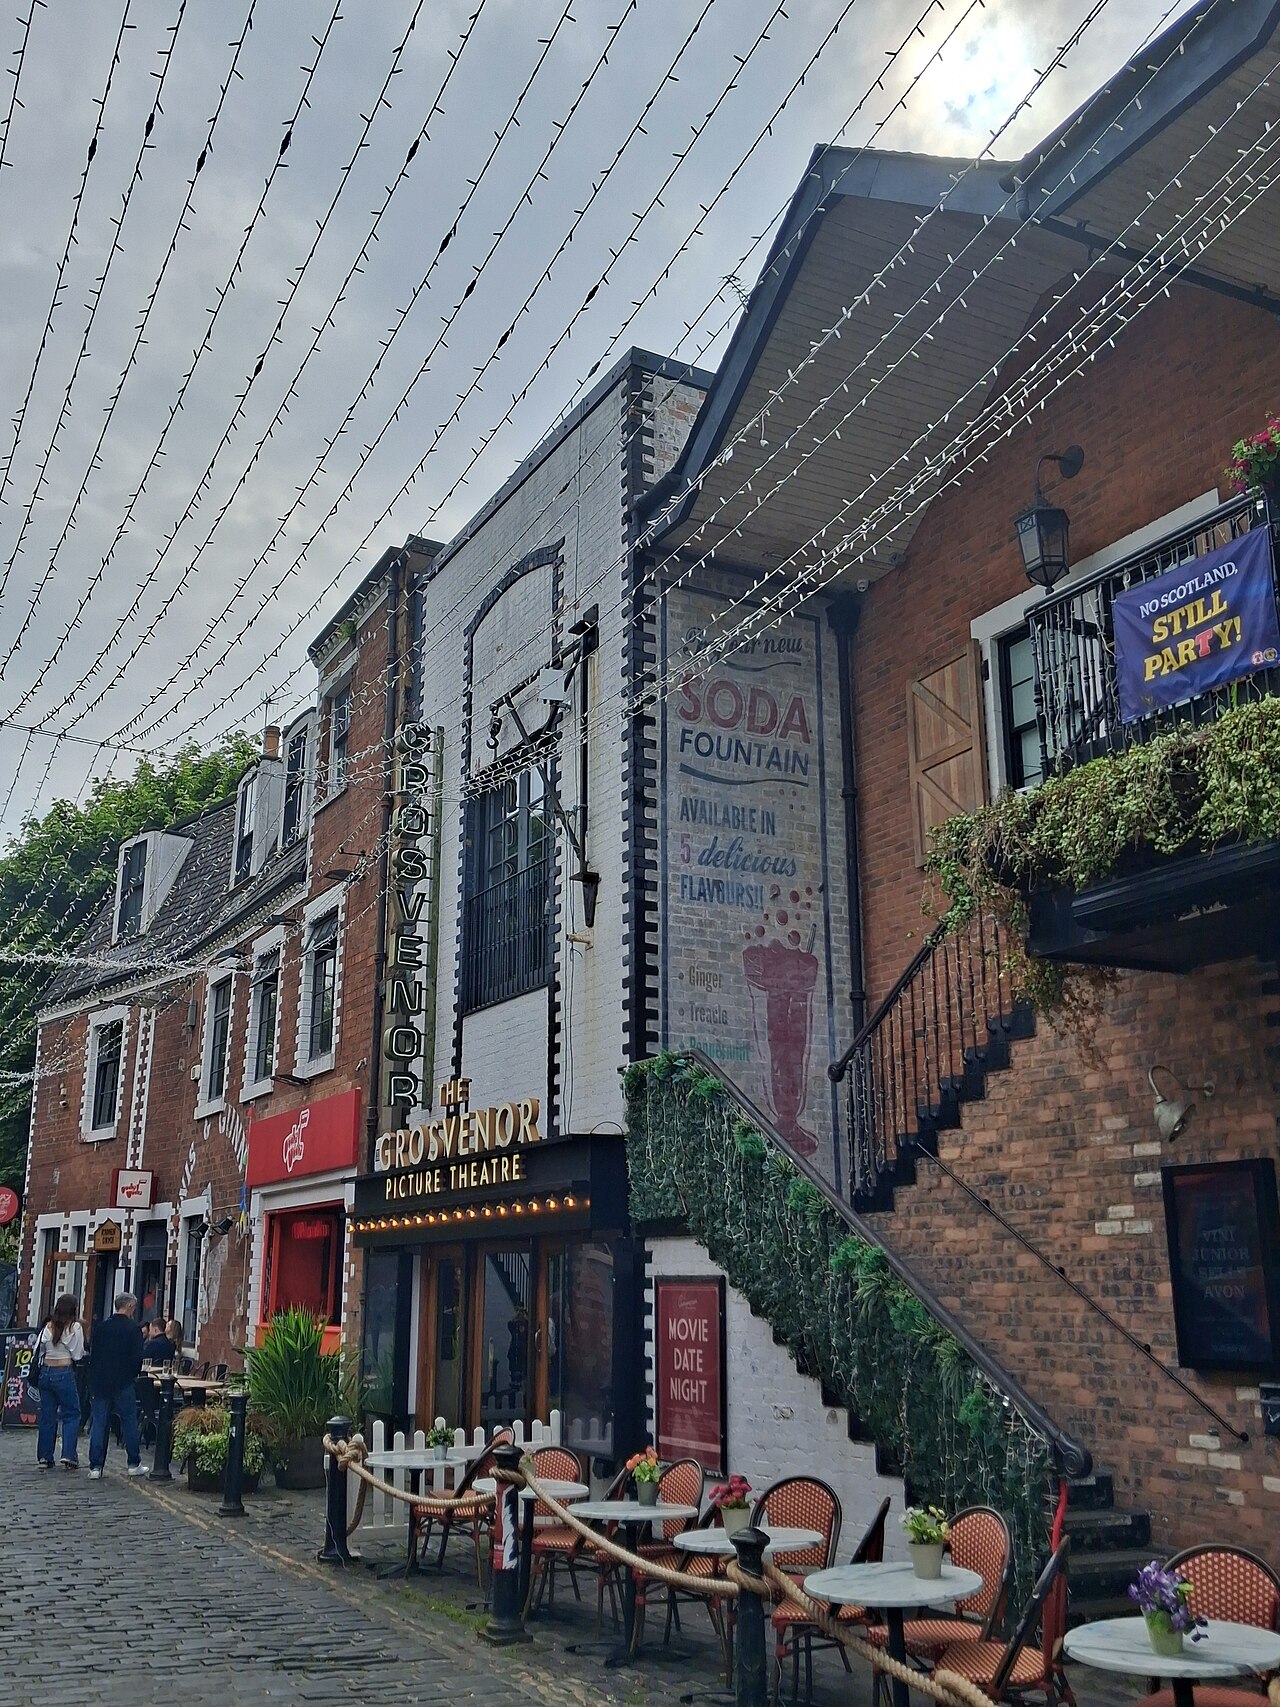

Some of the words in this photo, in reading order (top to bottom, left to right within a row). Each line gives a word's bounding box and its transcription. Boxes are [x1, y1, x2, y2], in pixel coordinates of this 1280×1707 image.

[1139, 599, 1160, 619] NO
[1160, 561, 1239, 609] SCOTLAND,
[1152, 589, 1228, 644] STILL
[763, 637, 804, 654] new
[1144, 615, 1242, 682] PARTY!
[677, 671, 811, 746] SODA
[679, 728, 809, 777] FOUNTAIN
[680, 797, 757, 832] AVAILABLE
[760, 808, 776, 836] IN
[680, 833, 692, 864] 5
[698, 836, 798, 878] delicious
[384, 722, 430, 1106] GROSVENOR
[688, 965, 723, 993] Ginger
[689, 1002, 729, 1026] Treacle
[439, 1078, 473, 1107] THE
[379, 1097, 541, 1171] GROSVENOR
[385, 1169, 441, 1200] PICTURE
[450, 1154, 520, 1190] THEATRE
[1204, 1284, 1246, 1298] AVON
[668, 1318, 708, 1342] MOVIE
[673, 1348, 703, 1372] DATE
[670, 1377, 708, 1403] NIGHT
